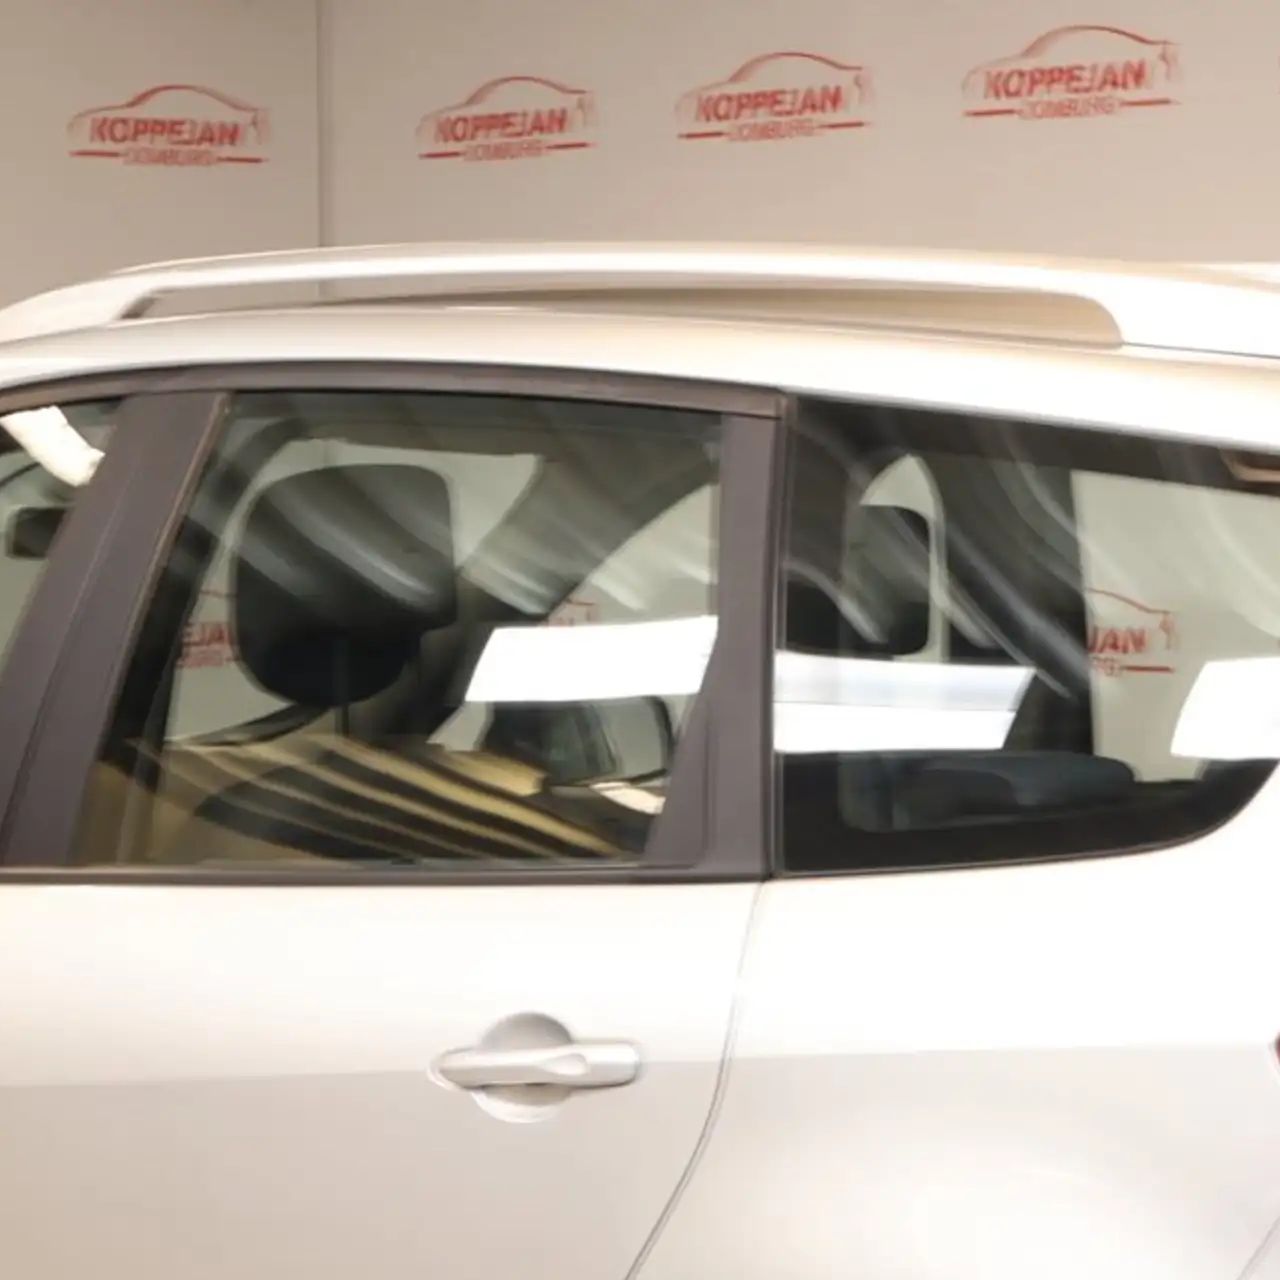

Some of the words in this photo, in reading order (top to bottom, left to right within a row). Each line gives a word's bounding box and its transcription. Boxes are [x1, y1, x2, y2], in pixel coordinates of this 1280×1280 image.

[984, 60, 1147, 100] KOPPEJAN
[696, 85, 843, 121] KOPPEJAN
[90, 117, 240, 146] KOPPEJAN
[435, 107, 568, 142] KOPPEJAN
